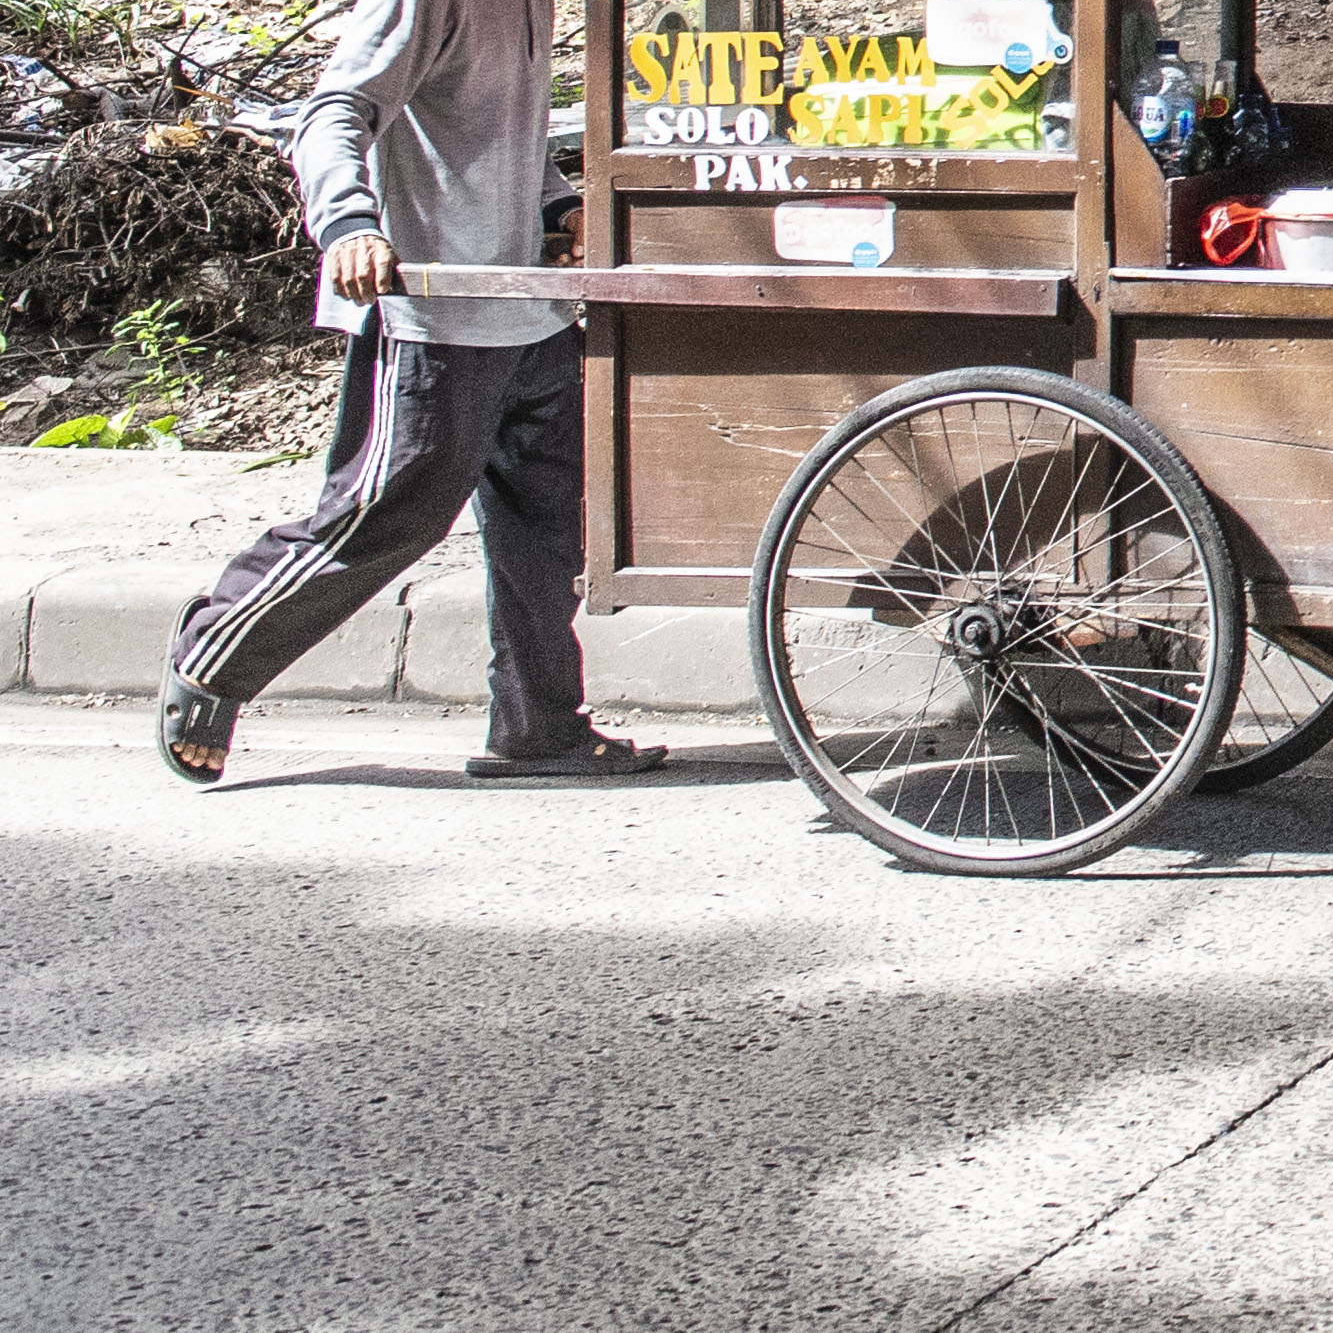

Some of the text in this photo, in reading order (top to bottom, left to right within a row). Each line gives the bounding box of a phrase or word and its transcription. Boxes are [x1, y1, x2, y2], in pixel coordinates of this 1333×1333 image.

[627, 31, 937, 105] SATE AYAM
[643, 105, 770, 146] SOLO
[788, 92, 925, 146] SAPI
[694, 154, 808, 192] PAK.
